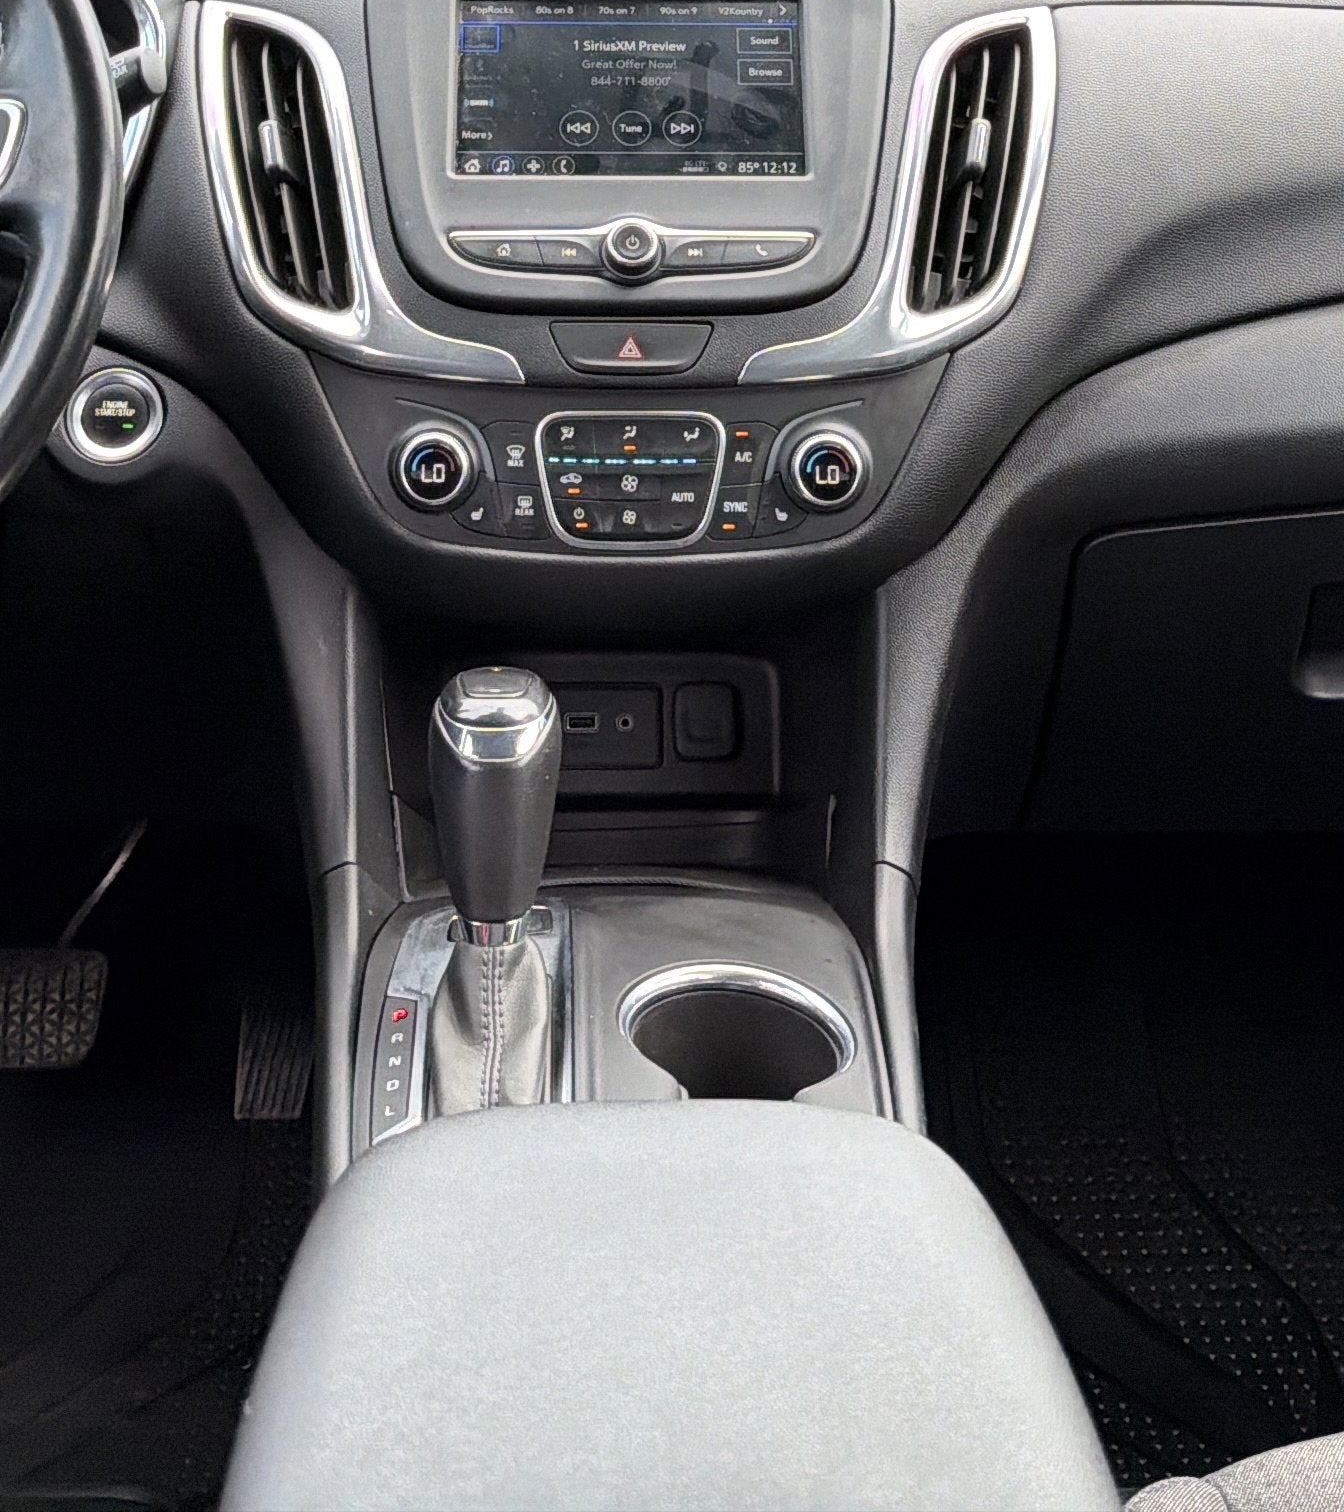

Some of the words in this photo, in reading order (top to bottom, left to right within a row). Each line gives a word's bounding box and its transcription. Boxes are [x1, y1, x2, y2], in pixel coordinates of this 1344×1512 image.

[471, 6, 514, 15] PopRocks
[567, 6, 574, 14] 8
[598, 6, 614, 15] 70s
[630, 6, 636, 15] 7
[660, 7, 676, 15] 90s
[691, 7, 698, 15] 9
[718, 7, 763, 17] V2Kountry
[573, 40, 579, 51] 1
[583, 40, 636, 51] SiriusXM
[639, 40, 687, 51] Preview
[750, 36, 779, 45] Sound
[581, 59, 613, 69] Great
[616, 59, 646, 69] Offer
[648, 59, 677, 69] Now!
[748, 67, 783, 76] Browse
[591, 75, 670, 86] 844-711-8800
[619, 124, 643, 133] Tune
[462, 130, 486, 139] More
[738, 162, 760, 173] 85°
[763, 161, 797, 173] 12:12
[102, 400, 128, 409] ENGINE
[94, 408, 136, 417] START/STOP
[735, 452, 752, 463] A/C
[507, 459, 524, 468] MAX
[422, 463, 446, 484] LO
[816, 465, 839, 484] LO
[671, 493, 694, 503] AUTO
[515, 508, 534, 516] REAR
[723, 502, 748, 513] SYNC
[392, 1009, 408, 1023] P
[389, 1055, 401, 1067] N
[386, 1080, 400, 1092] D
[385, 1106, 395, 1116] L
